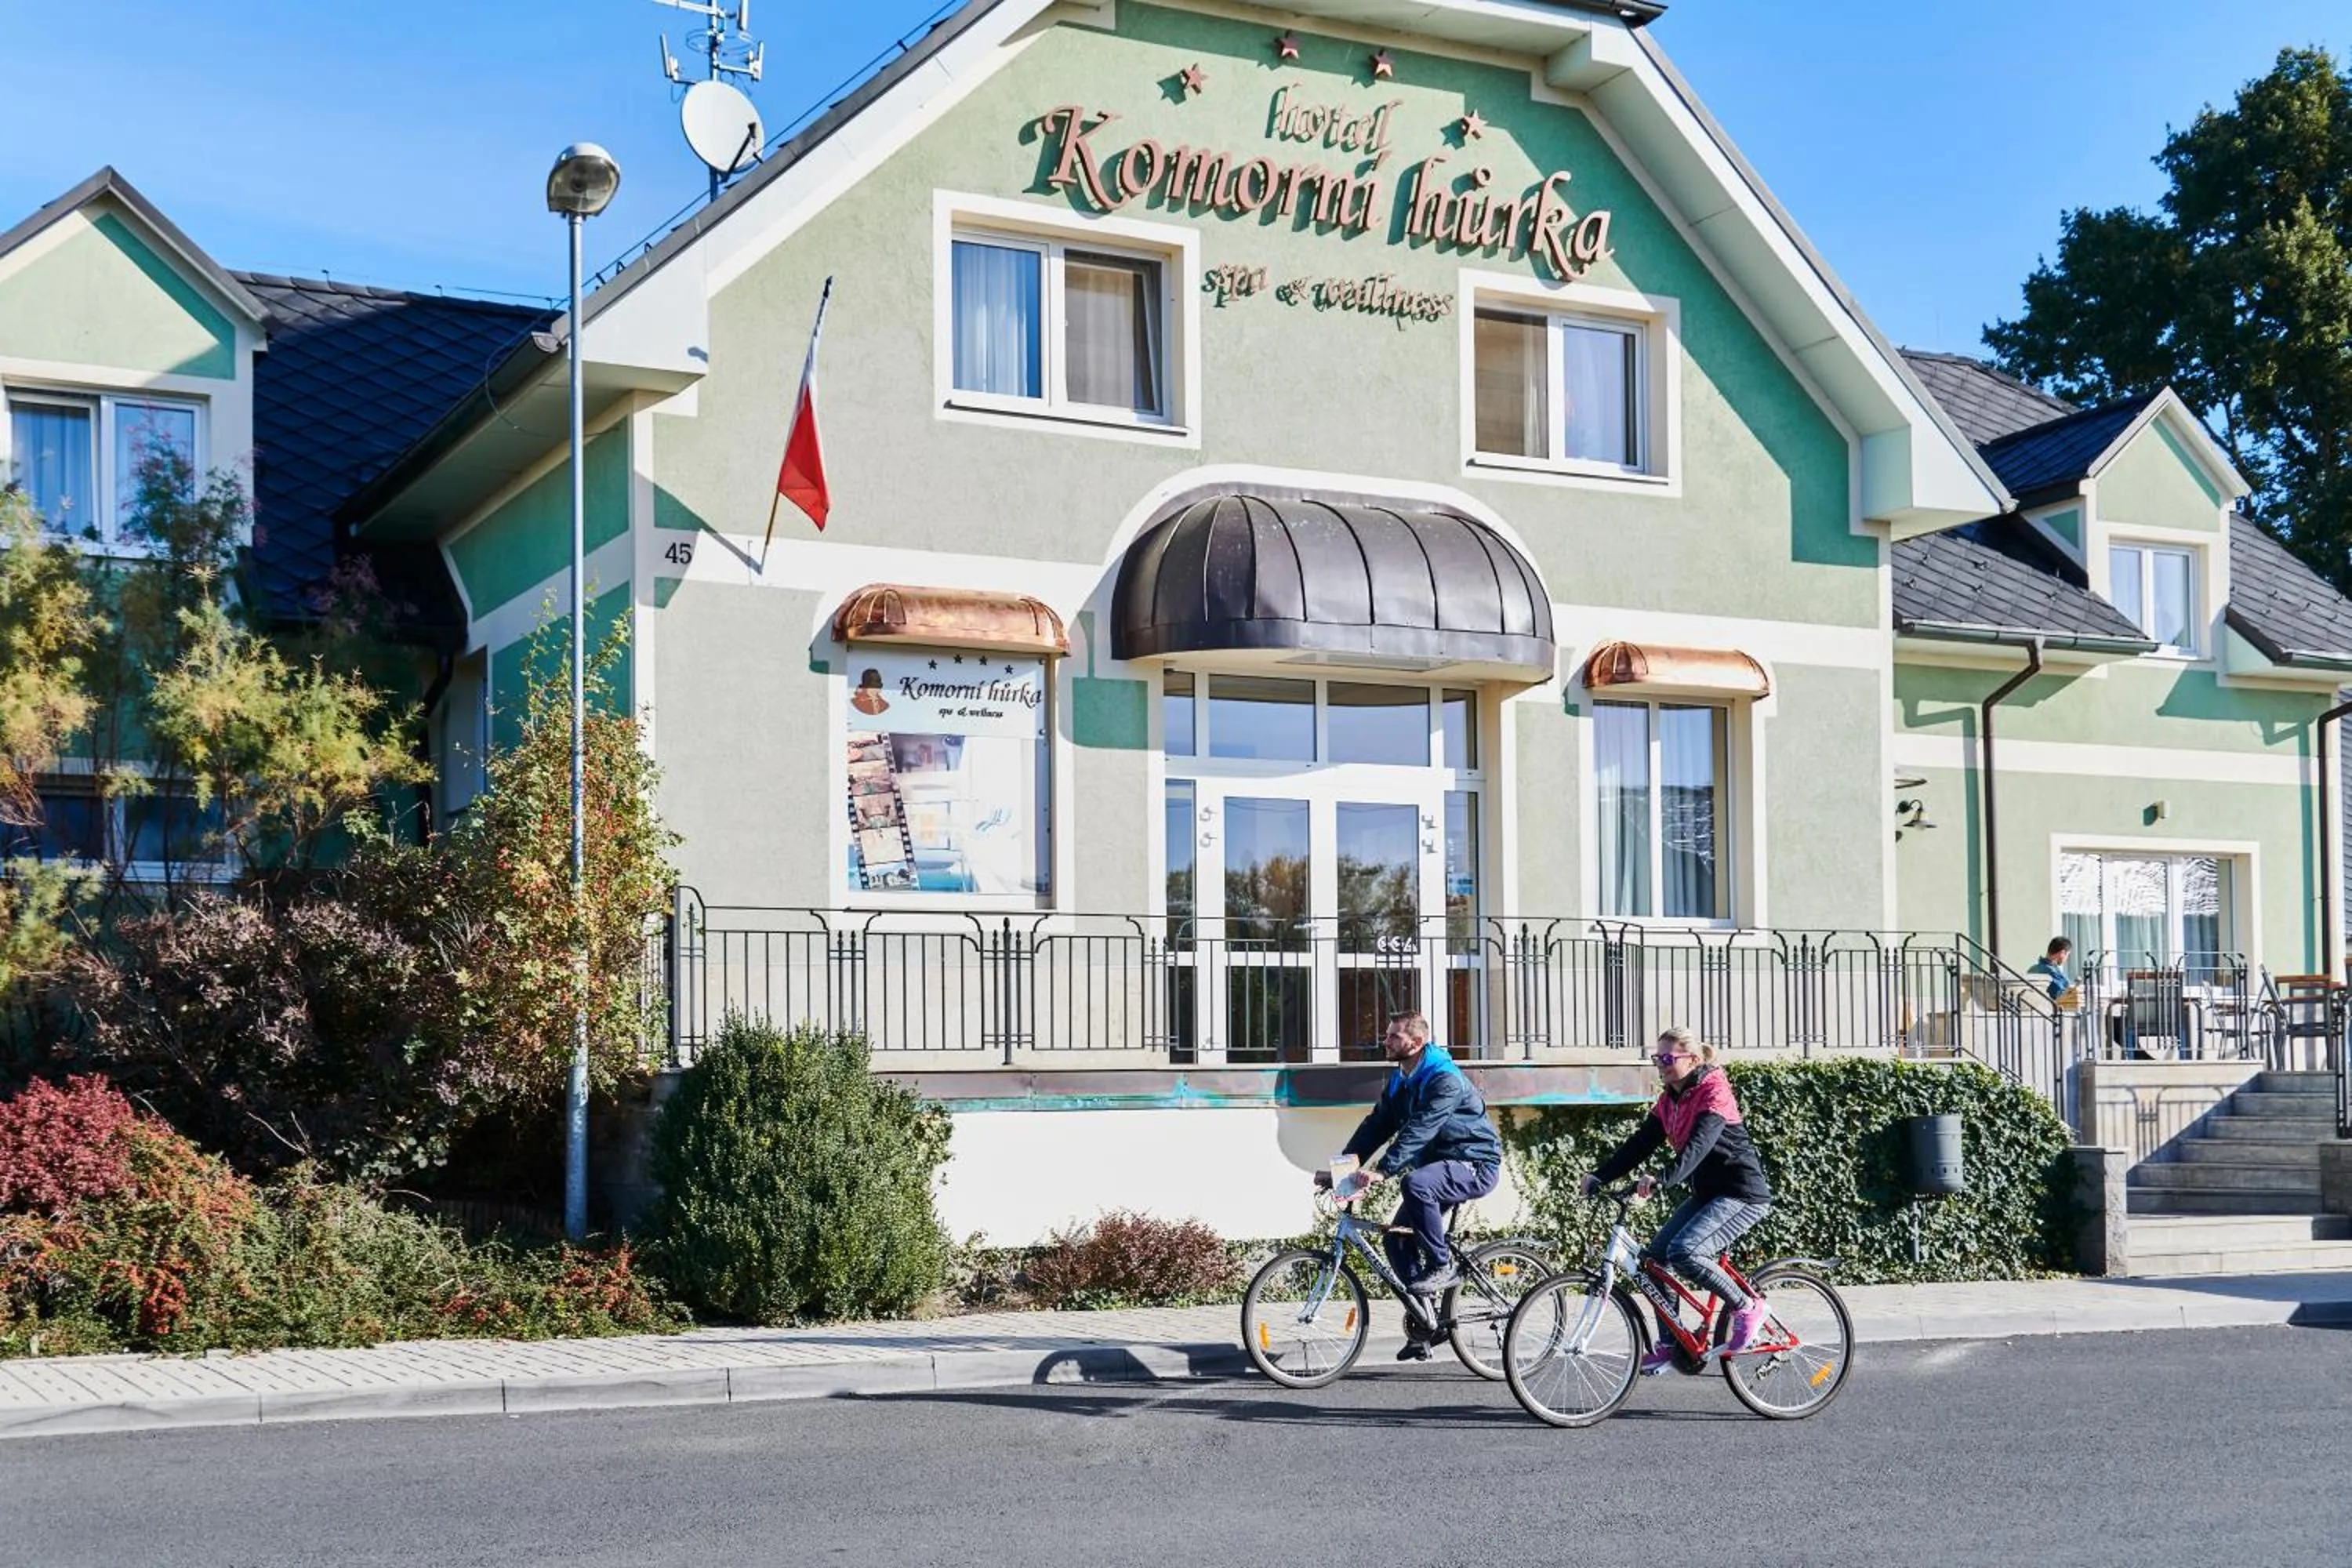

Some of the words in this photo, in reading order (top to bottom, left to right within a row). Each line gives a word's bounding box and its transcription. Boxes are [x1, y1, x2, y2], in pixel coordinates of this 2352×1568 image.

[1276, 78, 1403, 150] hotel
[1039, 104, 1391, 232] Komorní
[1408, 157, 1614, 279] hůrka
[1207, 263, 1269, 304] spa
[1319, 273, 1454, 320] wellness
[664, 543, 692, 564] 45
[899, 677, 985, 700] Komorní
[987, 679, 1043, 709] hůrka
[957, 706, 968, 717] &
[969, 707, 1004, 719] wellness
